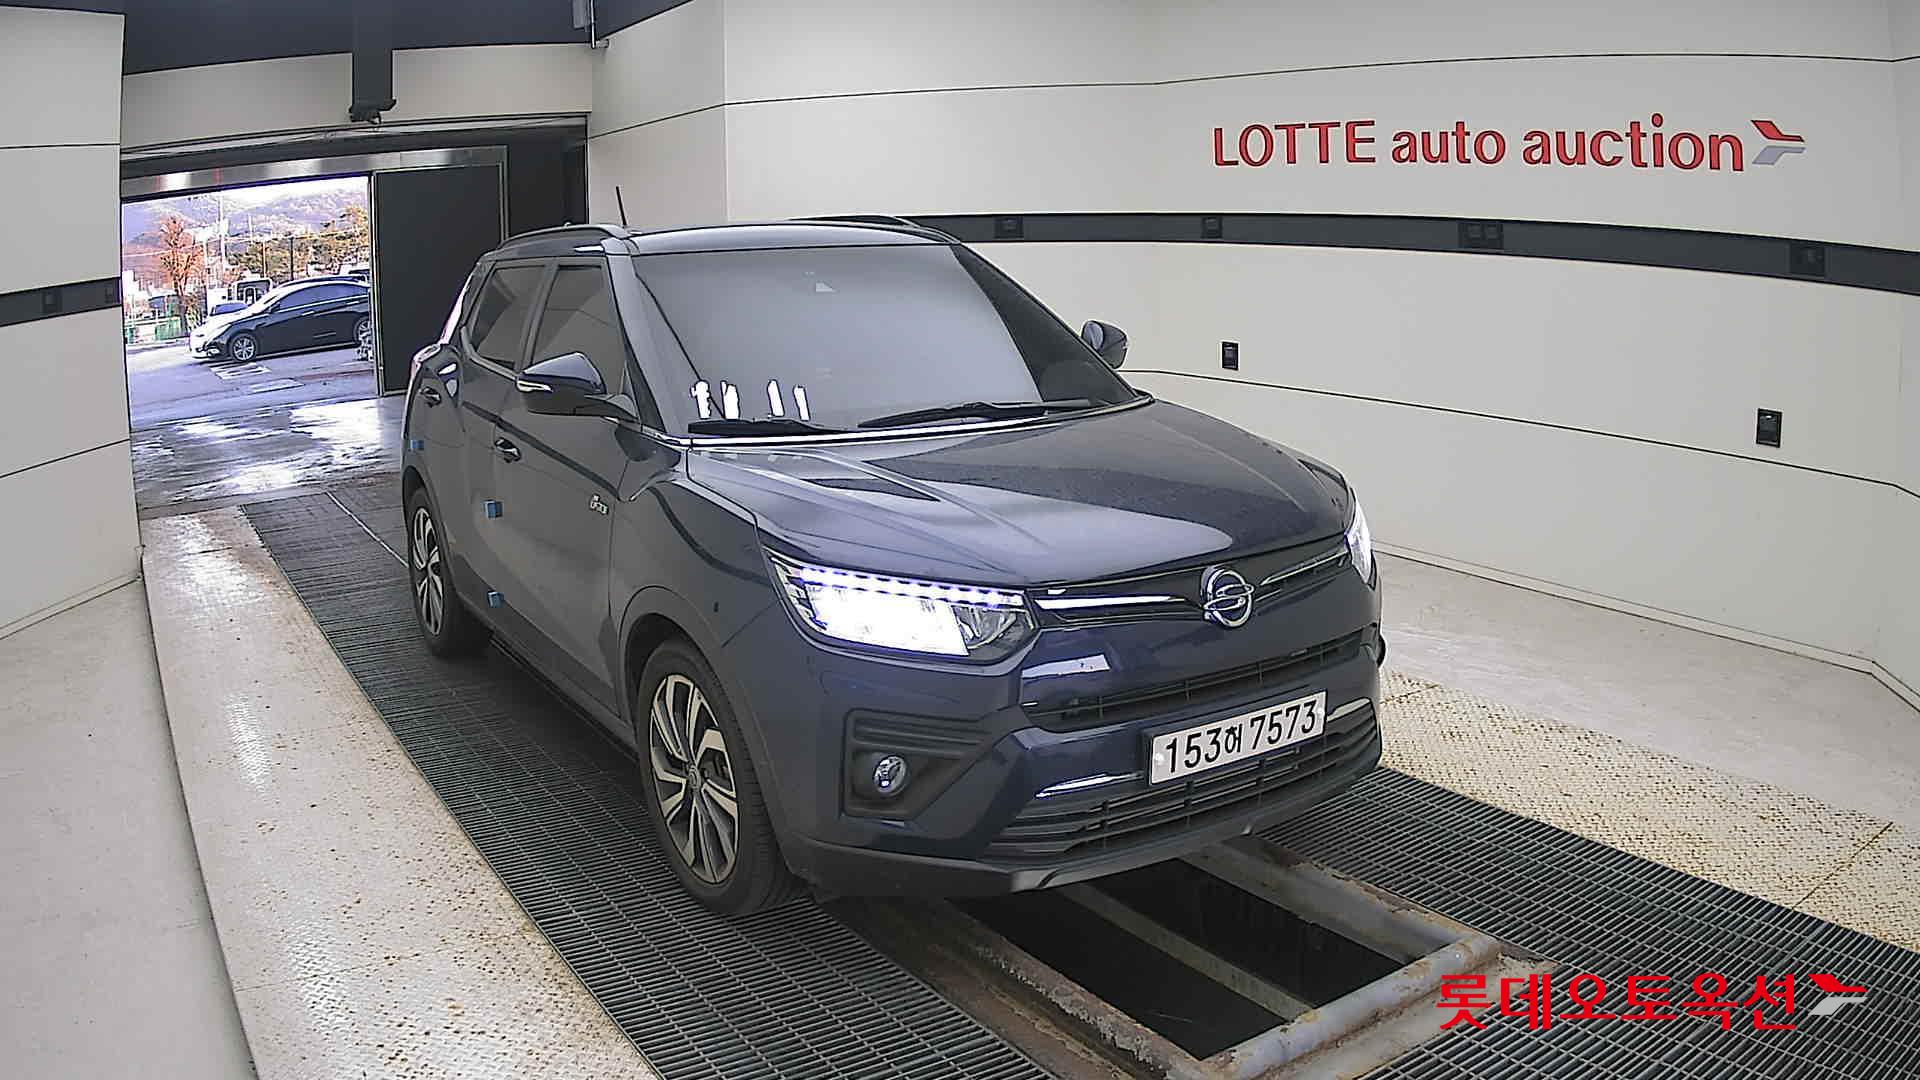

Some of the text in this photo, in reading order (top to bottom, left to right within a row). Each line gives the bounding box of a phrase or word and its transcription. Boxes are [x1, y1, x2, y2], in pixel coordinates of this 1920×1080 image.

[1212, 113, 1744, 172] LOTTE auto auction
